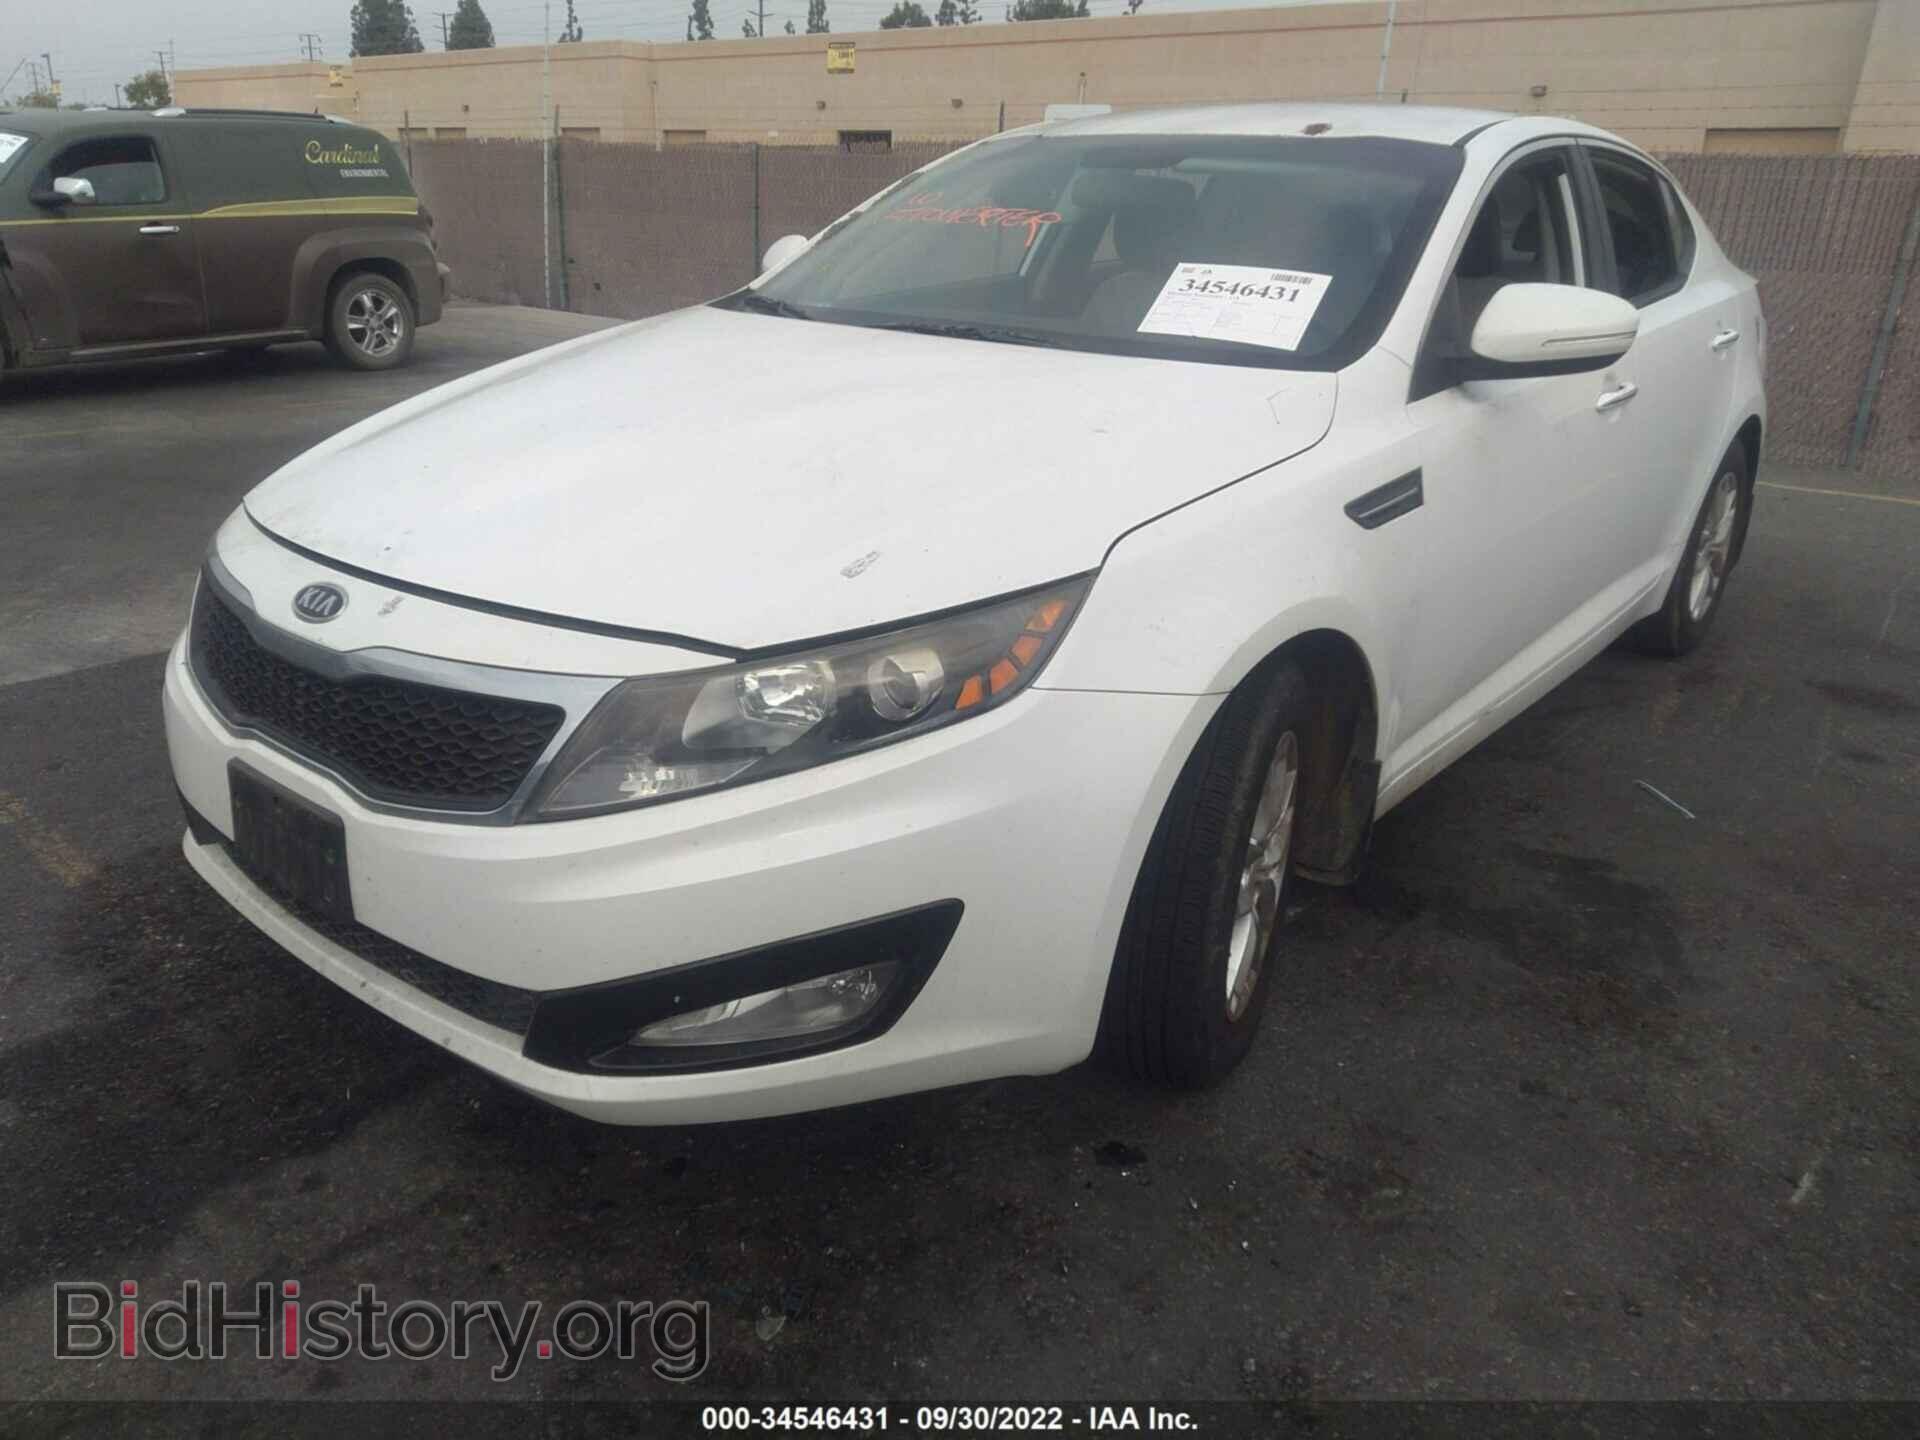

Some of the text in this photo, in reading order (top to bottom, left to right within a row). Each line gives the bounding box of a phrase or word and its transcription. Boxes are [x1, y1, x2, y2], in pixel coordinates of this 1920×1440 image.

[305, 140, 381, 164] Cardinal
[1178, 278, 1301, 303] 34546431
[298, 587, 337, 615] KIA
